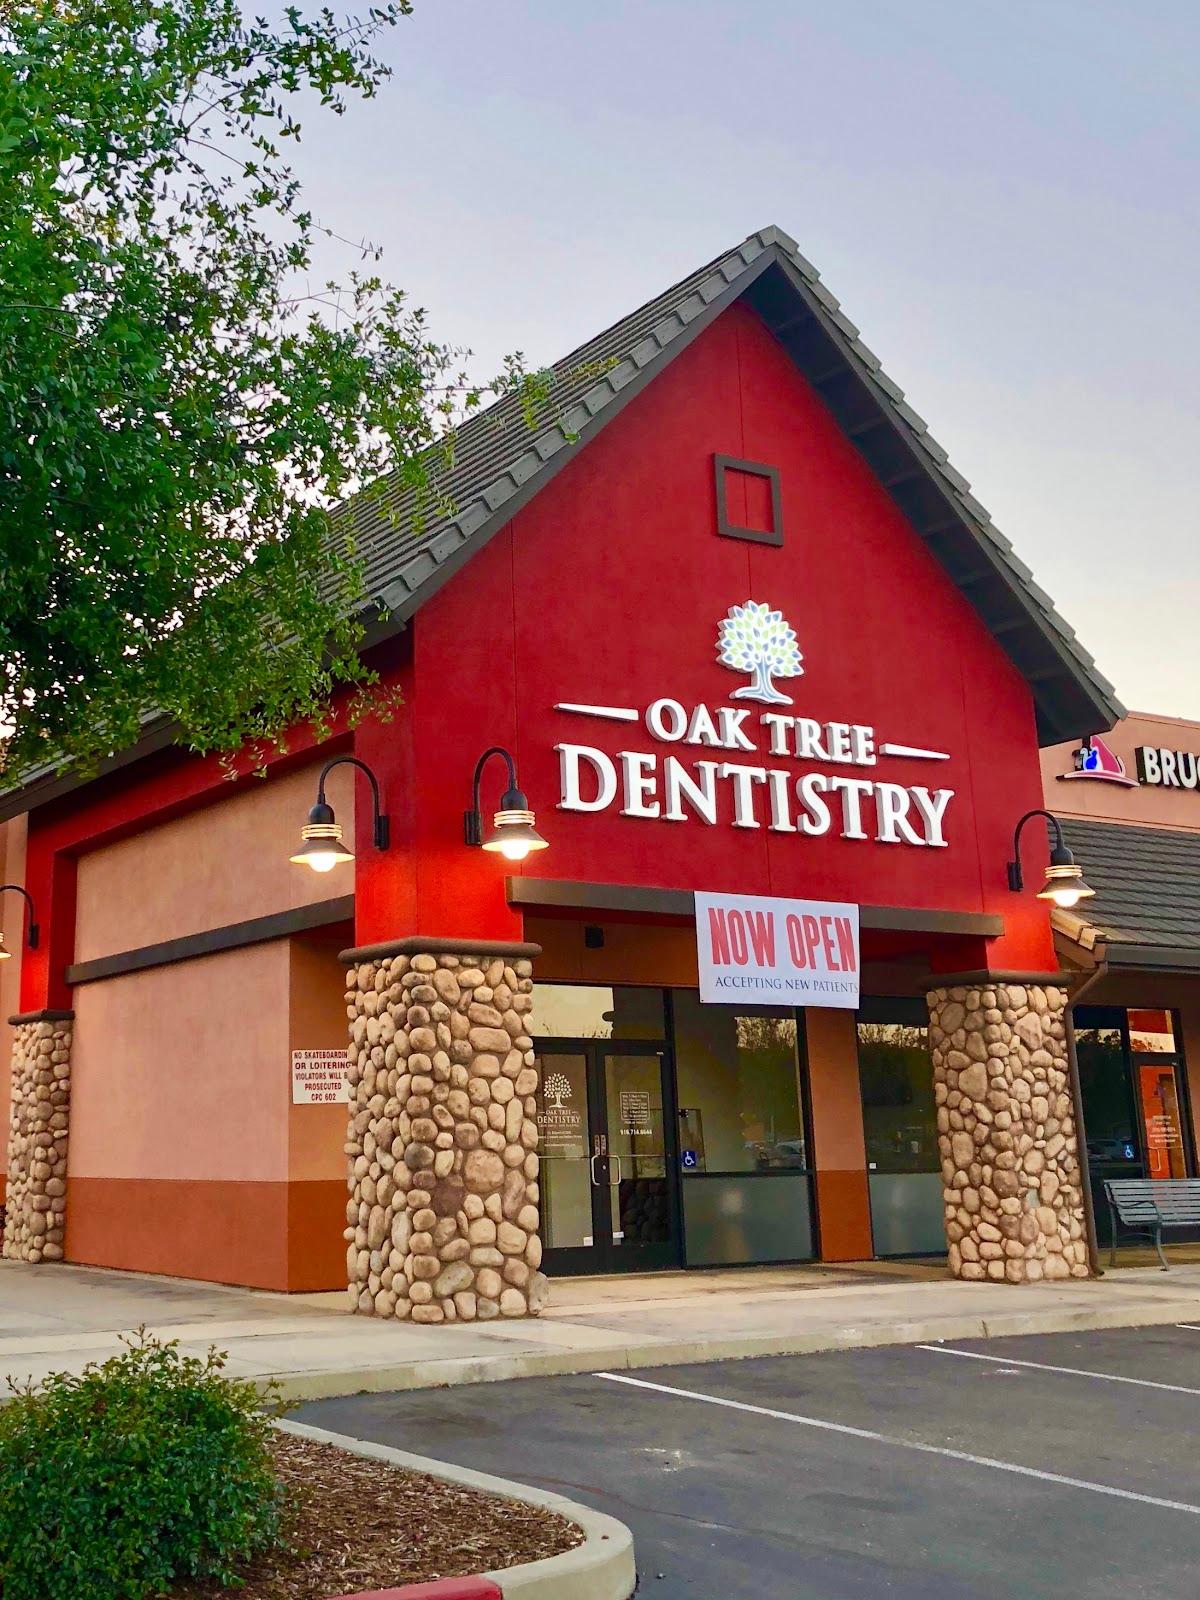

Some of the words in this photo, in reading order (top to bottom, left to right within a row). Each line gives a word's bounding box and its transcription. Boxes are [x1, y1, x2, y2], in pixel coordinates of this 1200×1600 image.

[646, 698, 757, 751] OAK
[760, 712, 877, 765] TREE
[553, 742, 955, 847] DENTISTRY
[708, 907, 776, 968] NOW
[785, 913, 857, 973] OPEN
[715, 976, 782, 990] ACCEPTING
[785, 979, 810, 991] NEW
[813, 980, 859, 994] PATIENTS
[304, 1051, 347, 1059] SKATEBOARDIN
[310, 1061, 351, 1070] LOITERING
[295, 1072, 326, 1080] VIOLATORS
[329, 1071, 342, 1080] WILL
[304, 1082, 342, 1091] PROSECUTED
[311, 1093, 323, 1101] CPC
[324, 1093, 337, 1101] 602
[537, 1115, 581, 1124] DENTISTRY
